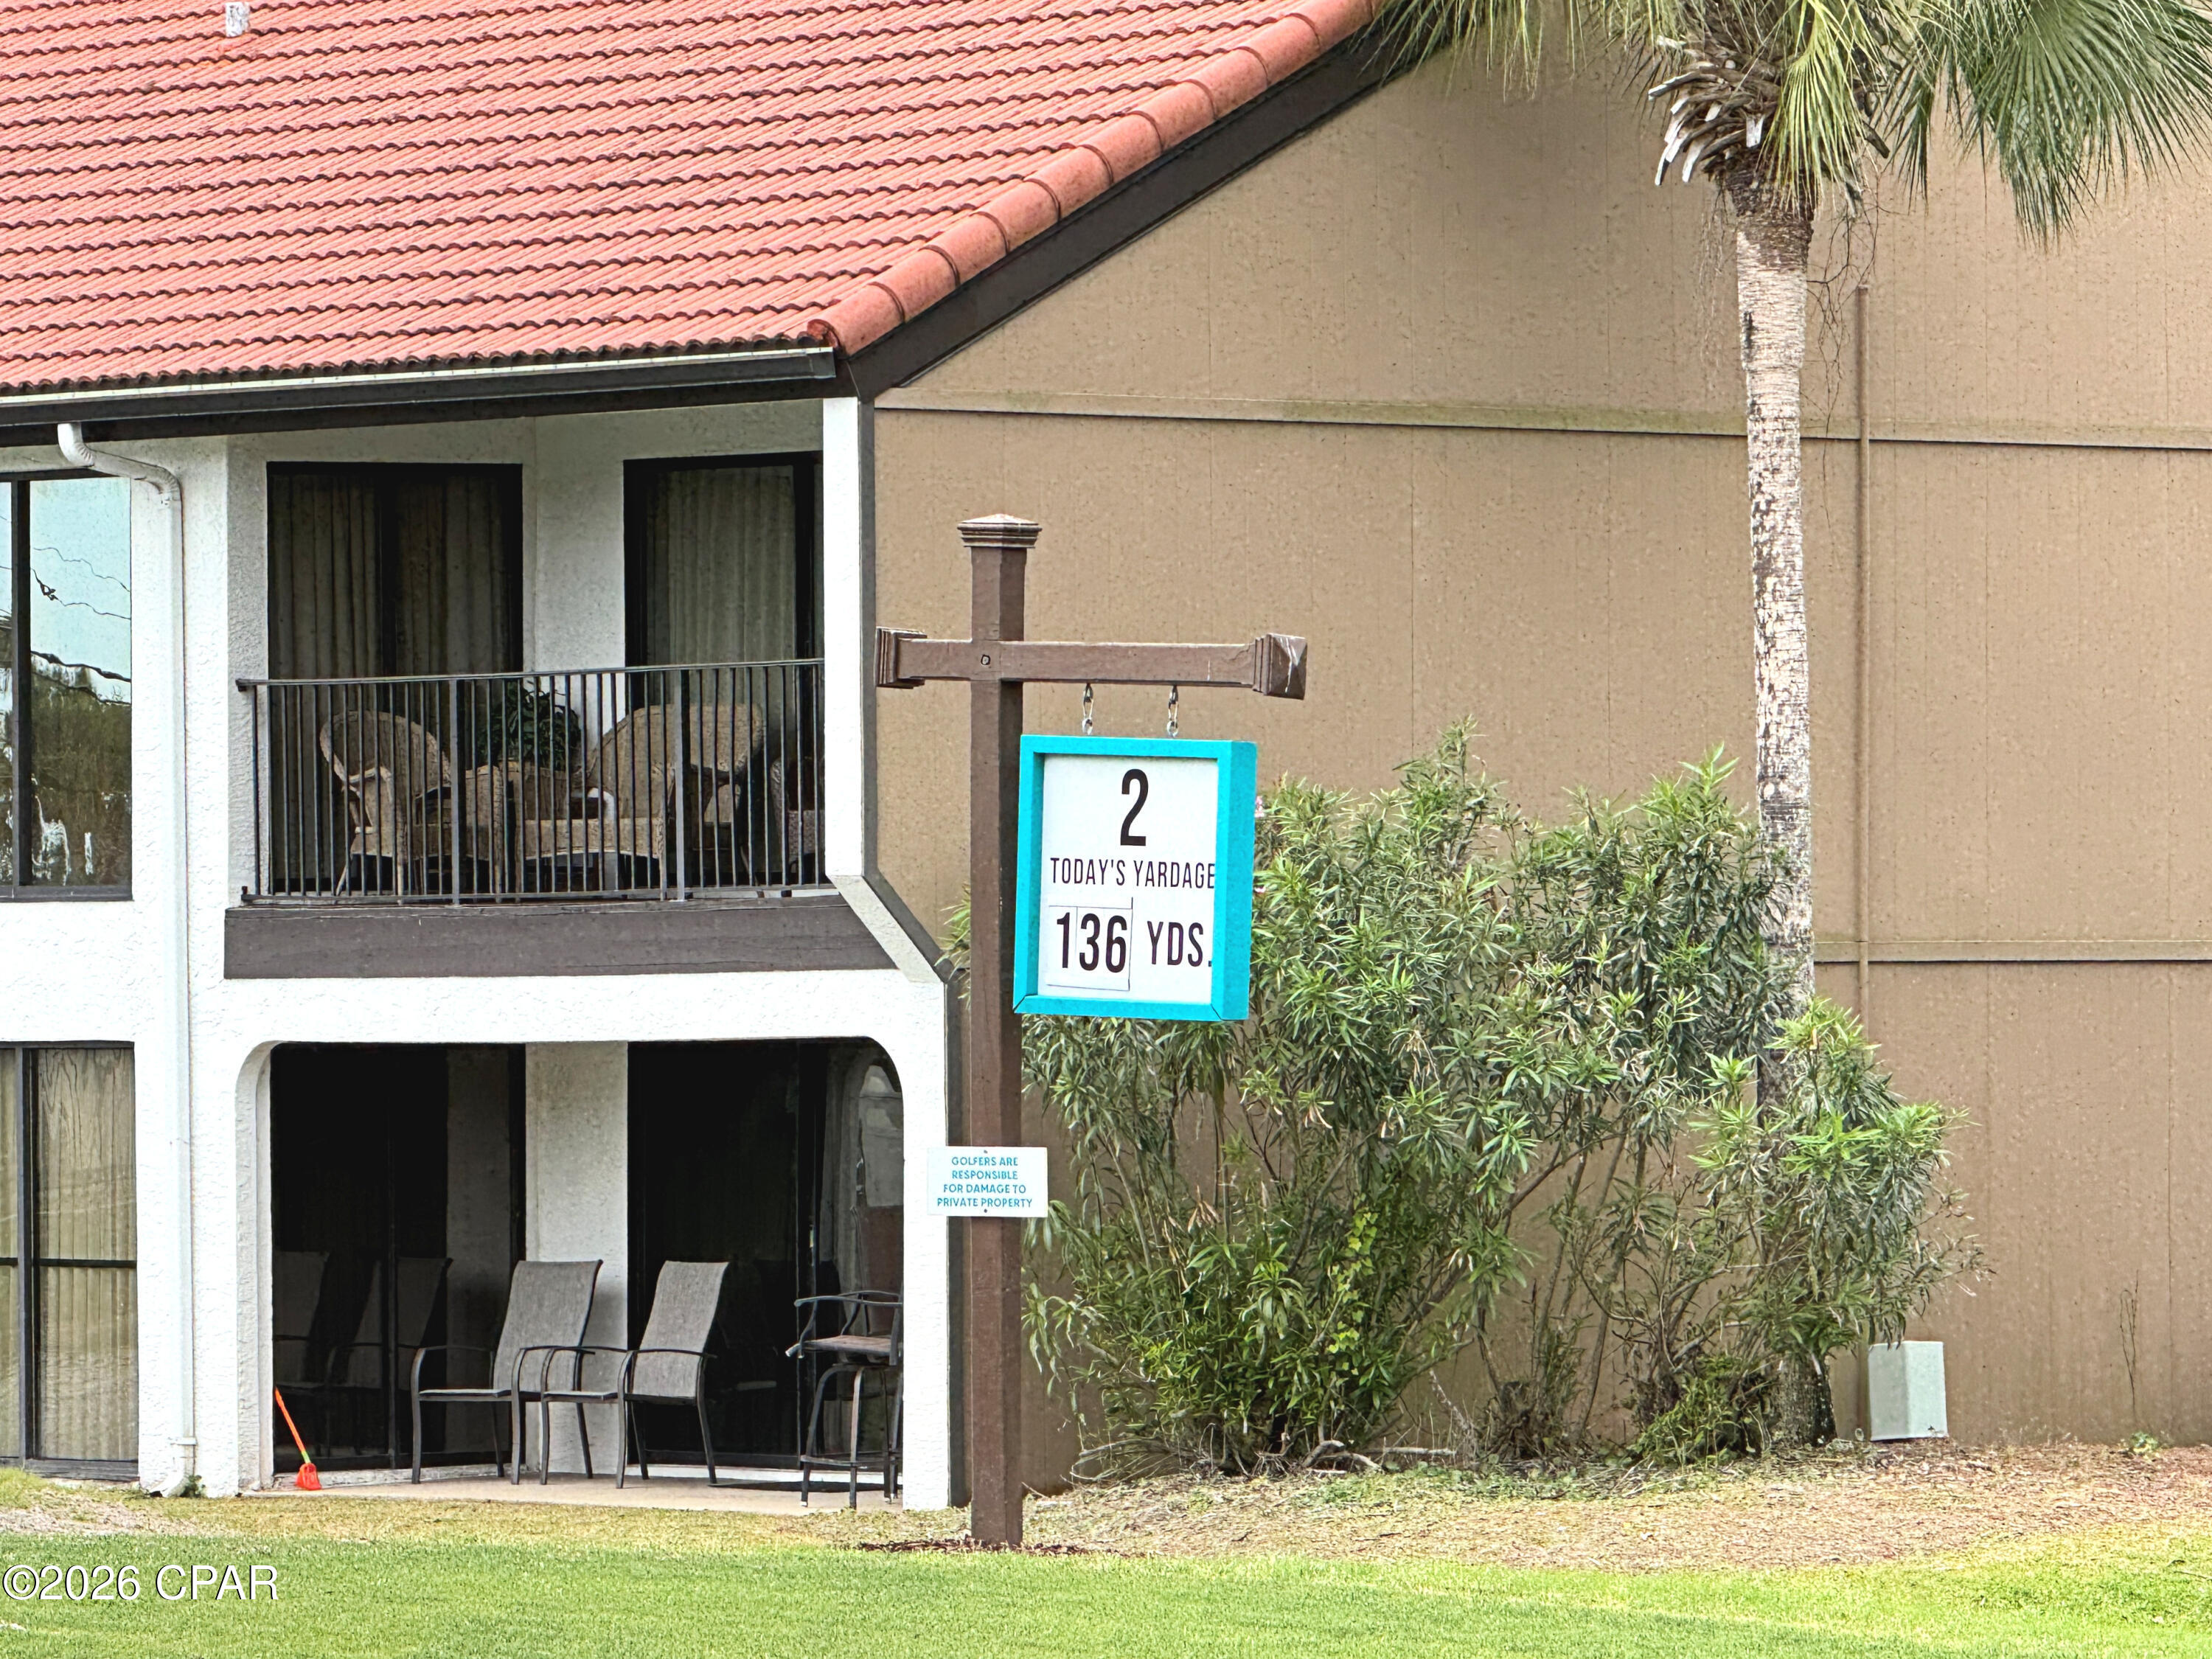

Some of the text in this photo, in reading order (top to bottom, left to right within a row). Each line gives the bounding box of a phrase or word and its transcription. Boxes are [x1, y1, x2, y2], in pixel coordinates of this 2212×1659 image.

[1120, 768, 1149, 846] 2
[1050, 858, 1215, 888] TODAY'S YARDAGE
[1057, 912, 1211, 973] 136 YDS.
[951, 1156, 1018, 1166] GOLFERS ARE
[952, 1170, 1018, 1180] RESPONSIBLE
[943, 1183, 1026, 1194] FOR DAMAGE TO
[937, 1197, 1032, 1207] PRIVATE PROPERTY
